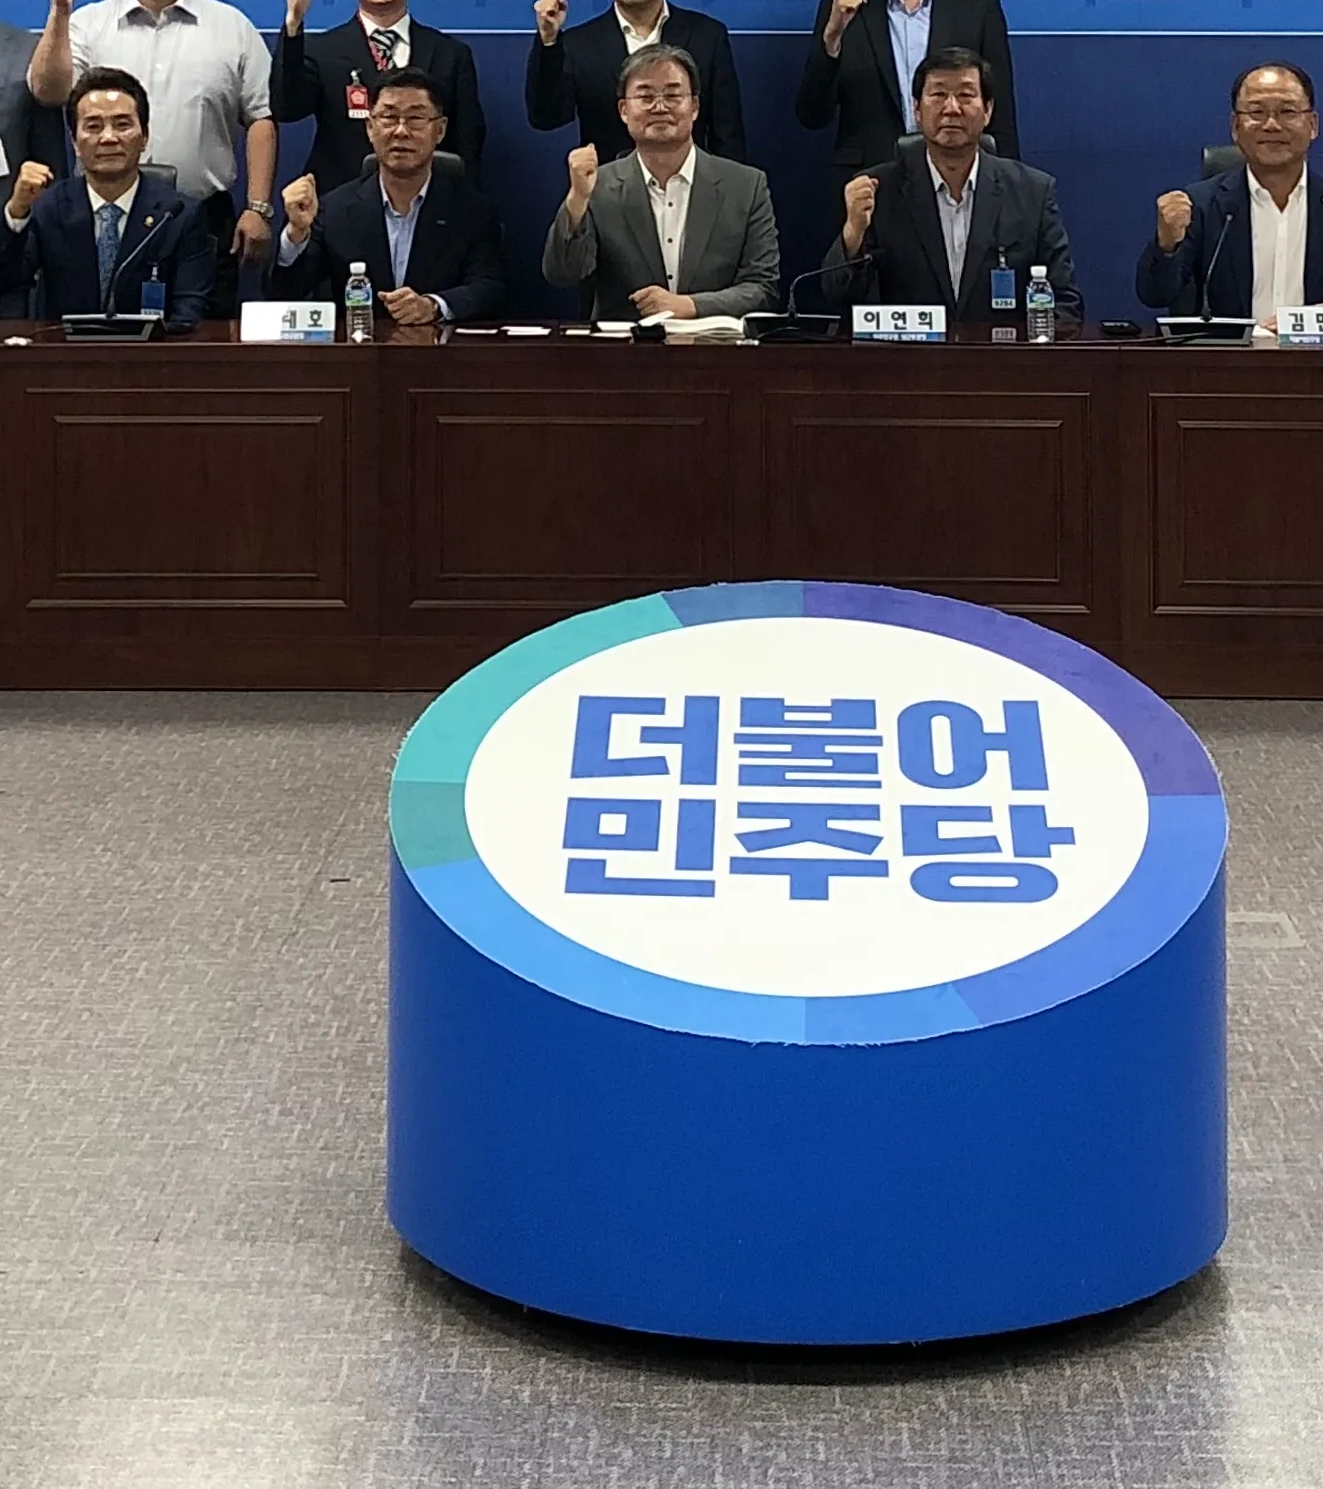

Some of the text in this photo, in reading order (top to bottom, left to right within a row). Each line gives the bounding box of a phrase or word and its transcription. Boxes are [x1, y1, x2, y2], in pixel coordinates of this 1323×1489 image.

[863, 311, 933, 331] 이연희
[569, 695, 1050, 791] 더불어
[561, 797, 1076, 903] 민주당
